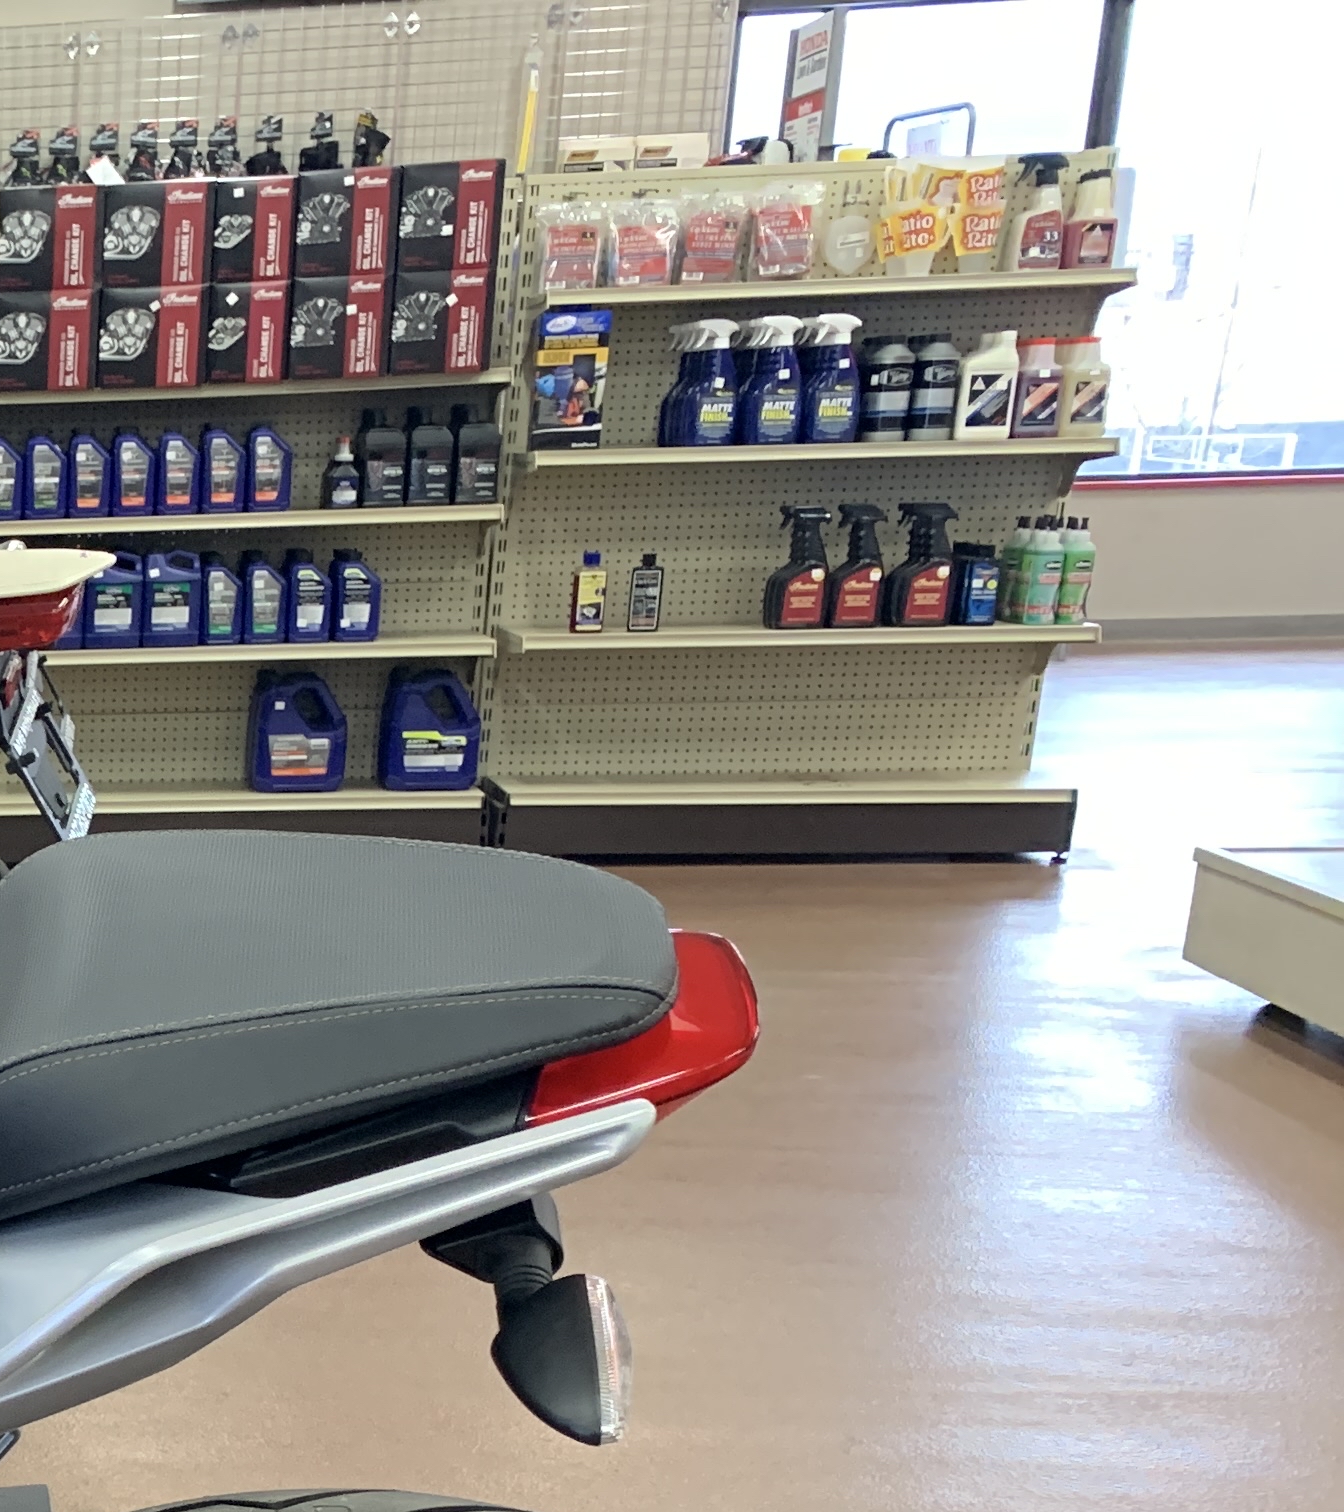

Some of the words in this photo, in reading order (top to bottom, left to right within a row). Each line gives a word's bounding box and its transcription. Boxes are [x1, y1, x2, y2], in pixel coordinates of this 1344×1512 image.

[763, 401, 796, 410] MATTE
[821, 398, 853, 407] MATTE
[702, 403, 733, 413] MATTE
